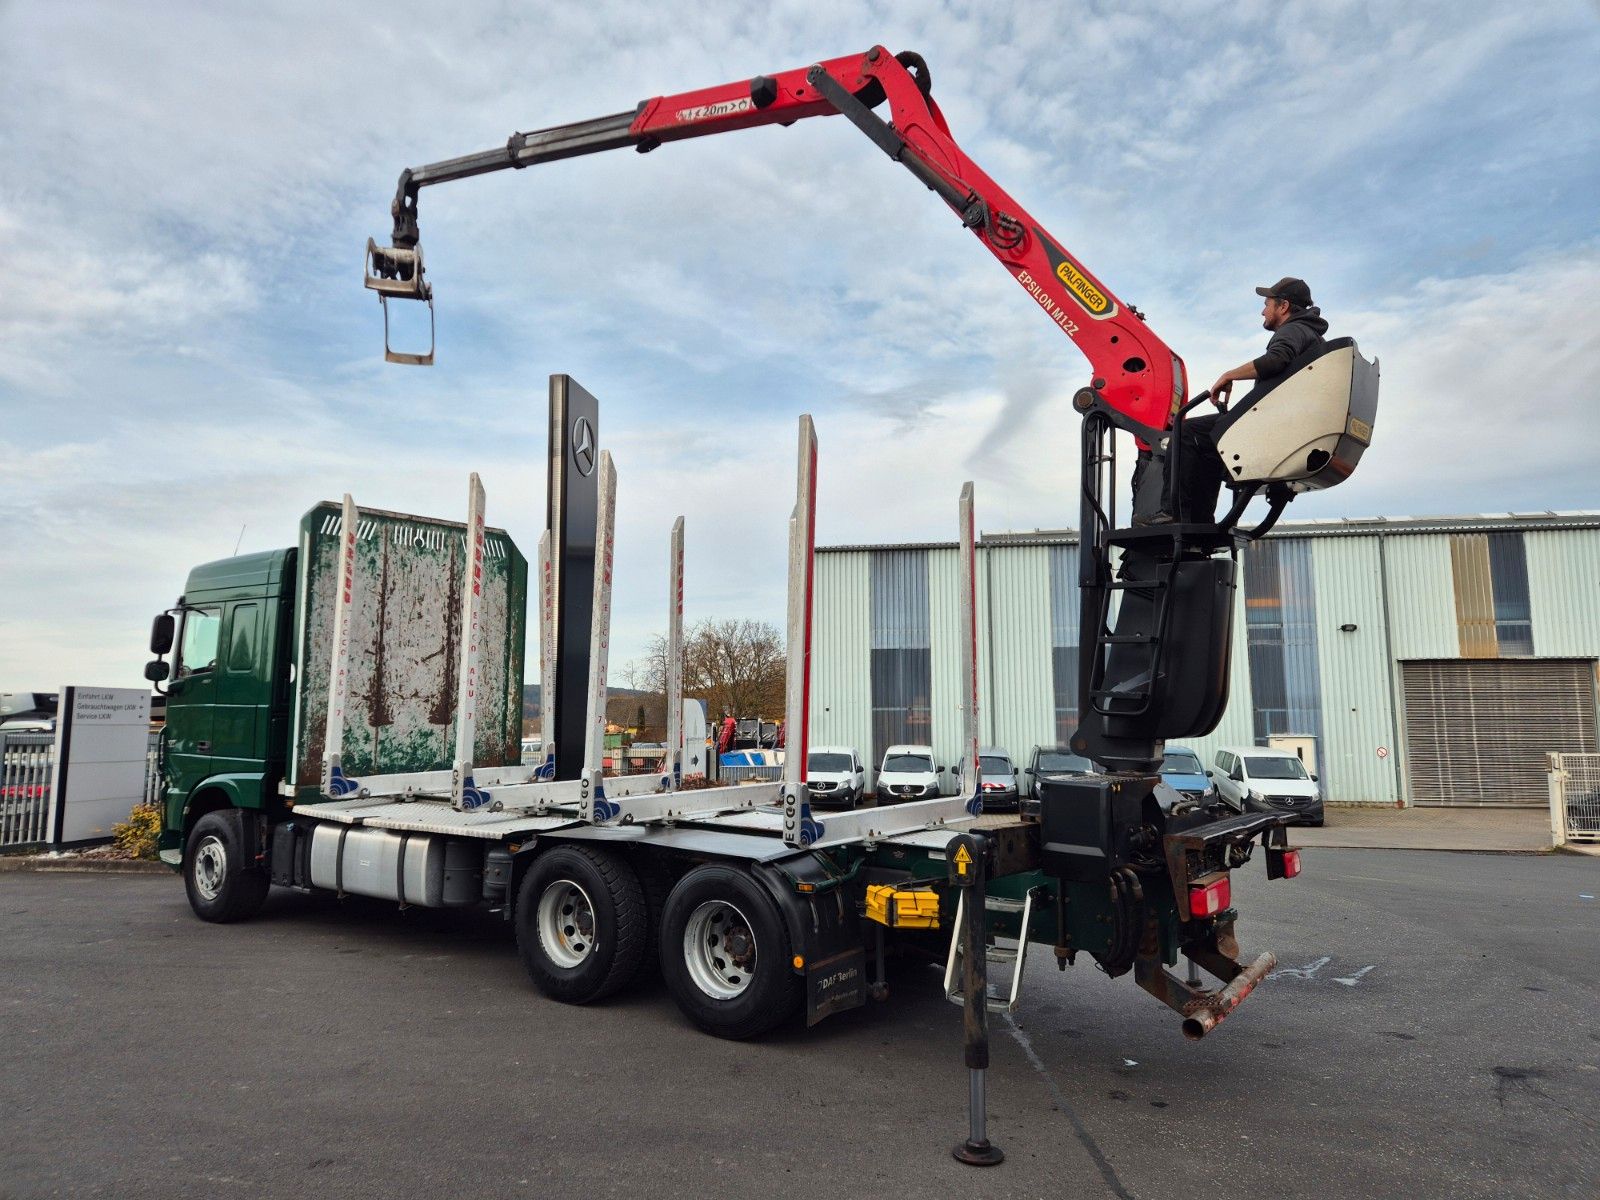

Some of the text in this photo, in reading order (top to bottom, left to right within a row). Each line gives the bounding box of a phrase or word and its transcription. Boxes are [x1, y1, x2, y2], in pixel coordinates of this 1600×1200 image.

[1017, 270, 1080, 337] EPSILON M12Z
[1060, 265, 1103, 309] PALFINGER
[76, 703, 123, 712] Gebrauchtwagen
